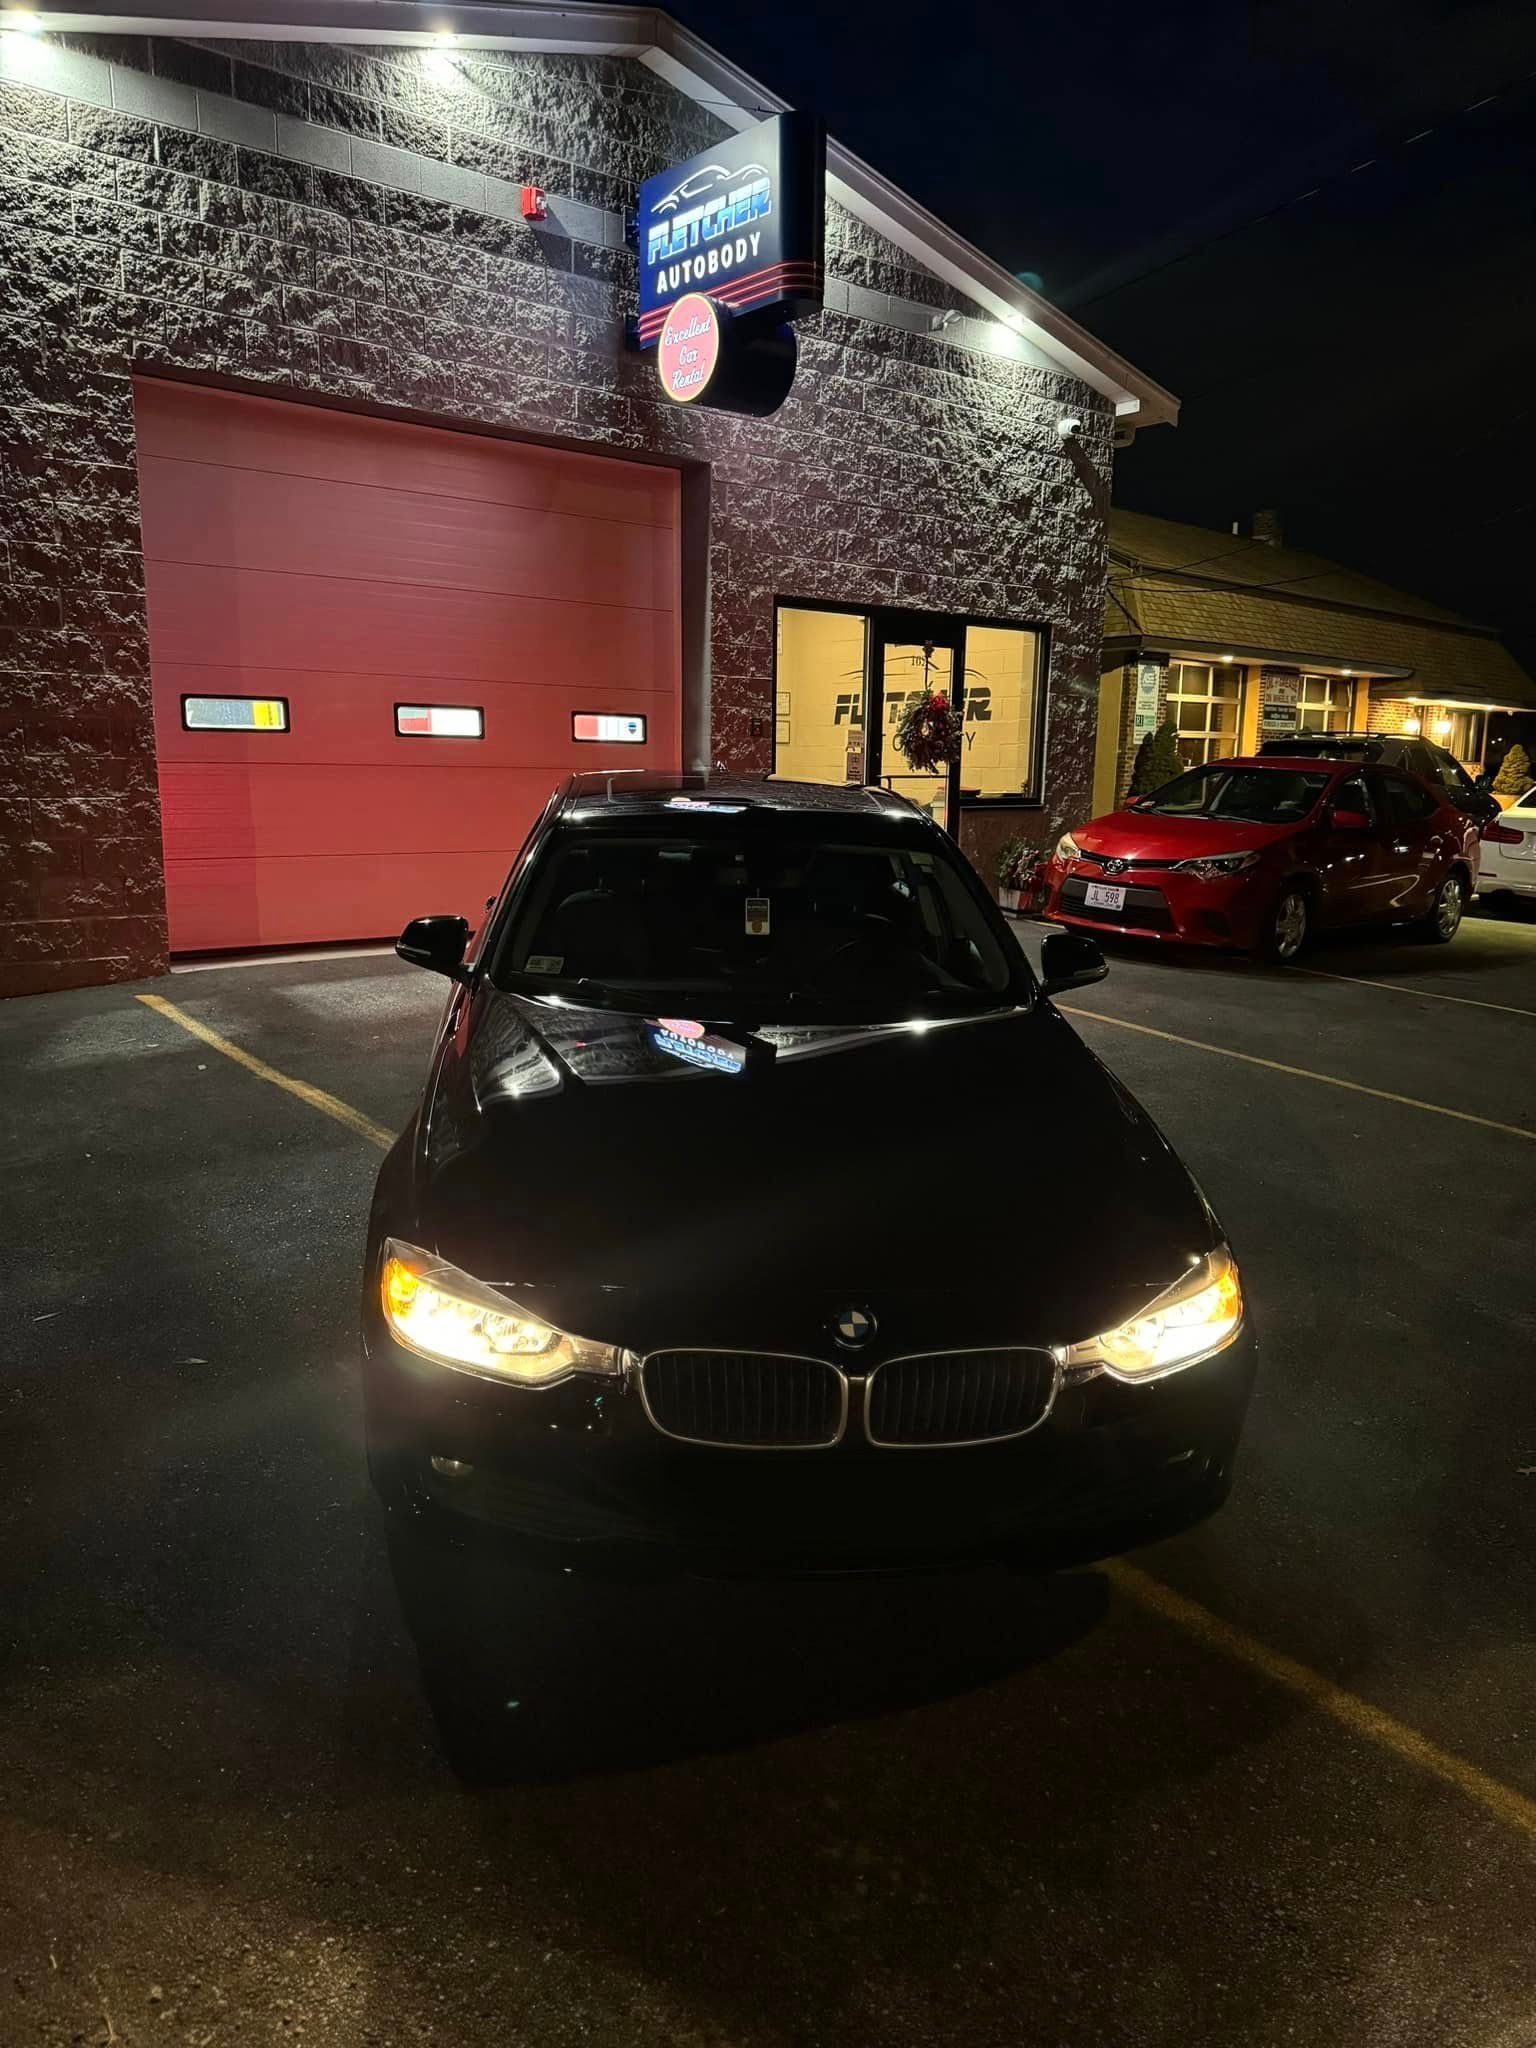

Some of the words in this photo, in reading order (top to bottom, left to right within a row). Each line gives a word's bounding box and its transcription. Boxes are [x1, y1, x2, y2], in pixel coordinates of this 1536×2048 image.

[648, 177, 771, 266] FLETCHER
[656, 232, 761, 294] AUTOBODY
[665, 314, 711, 346] Excellent
[679, 345, 699, 366] Car
[672, 359, 706, 391] Rental
[1104, 891, 1120, 904] 598
